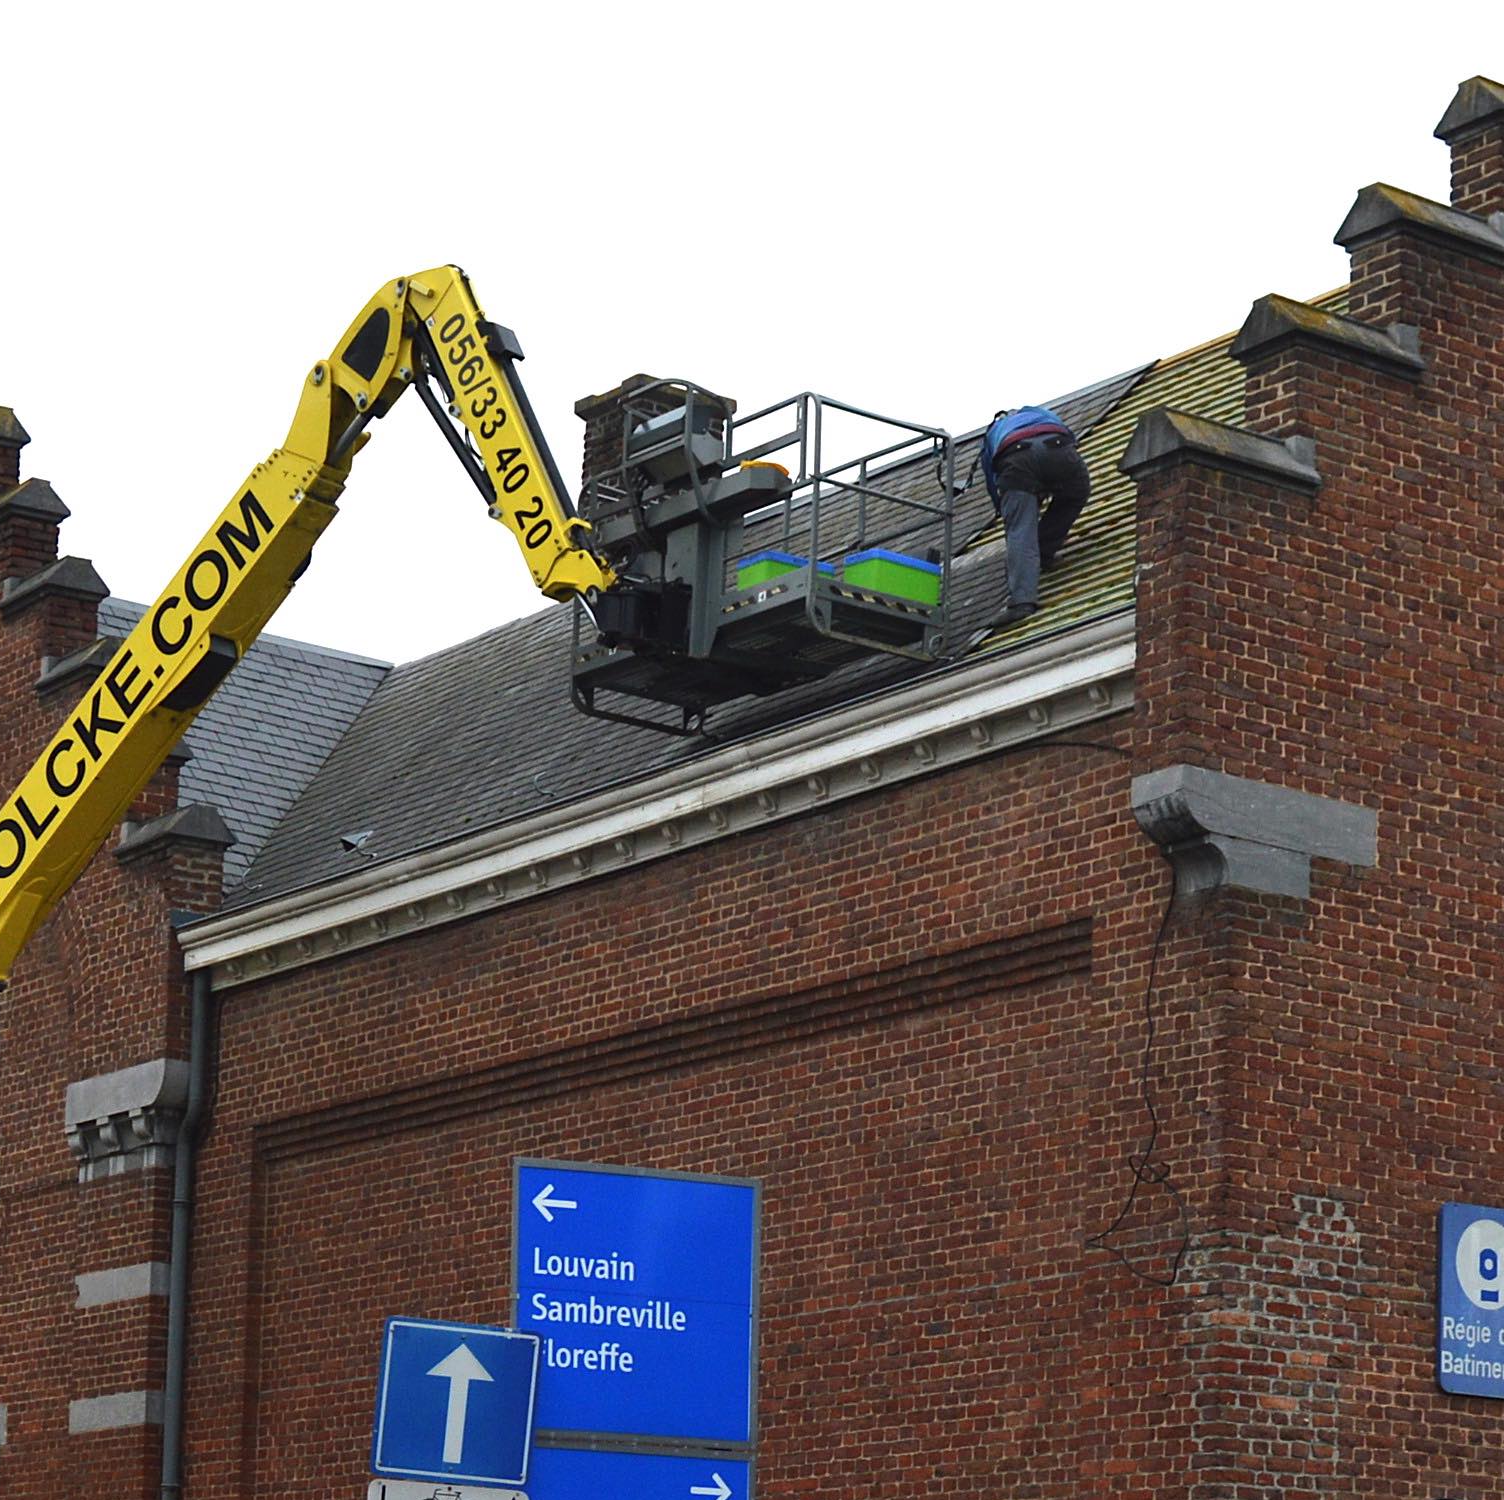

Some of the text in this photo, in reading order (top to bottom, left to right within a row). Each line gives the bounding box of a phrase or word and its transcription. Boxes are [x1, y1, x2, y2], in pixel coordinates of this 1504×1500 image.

[440, 313, 552, 549] 056/33 40 20
[533, 1247, 635, 1281] Louvain
[532, 1293, 686, 1332] Sambreville
[1443, 1316, 1490, 1347] Régie
[543, 1338, 633, 1372] loreffe
